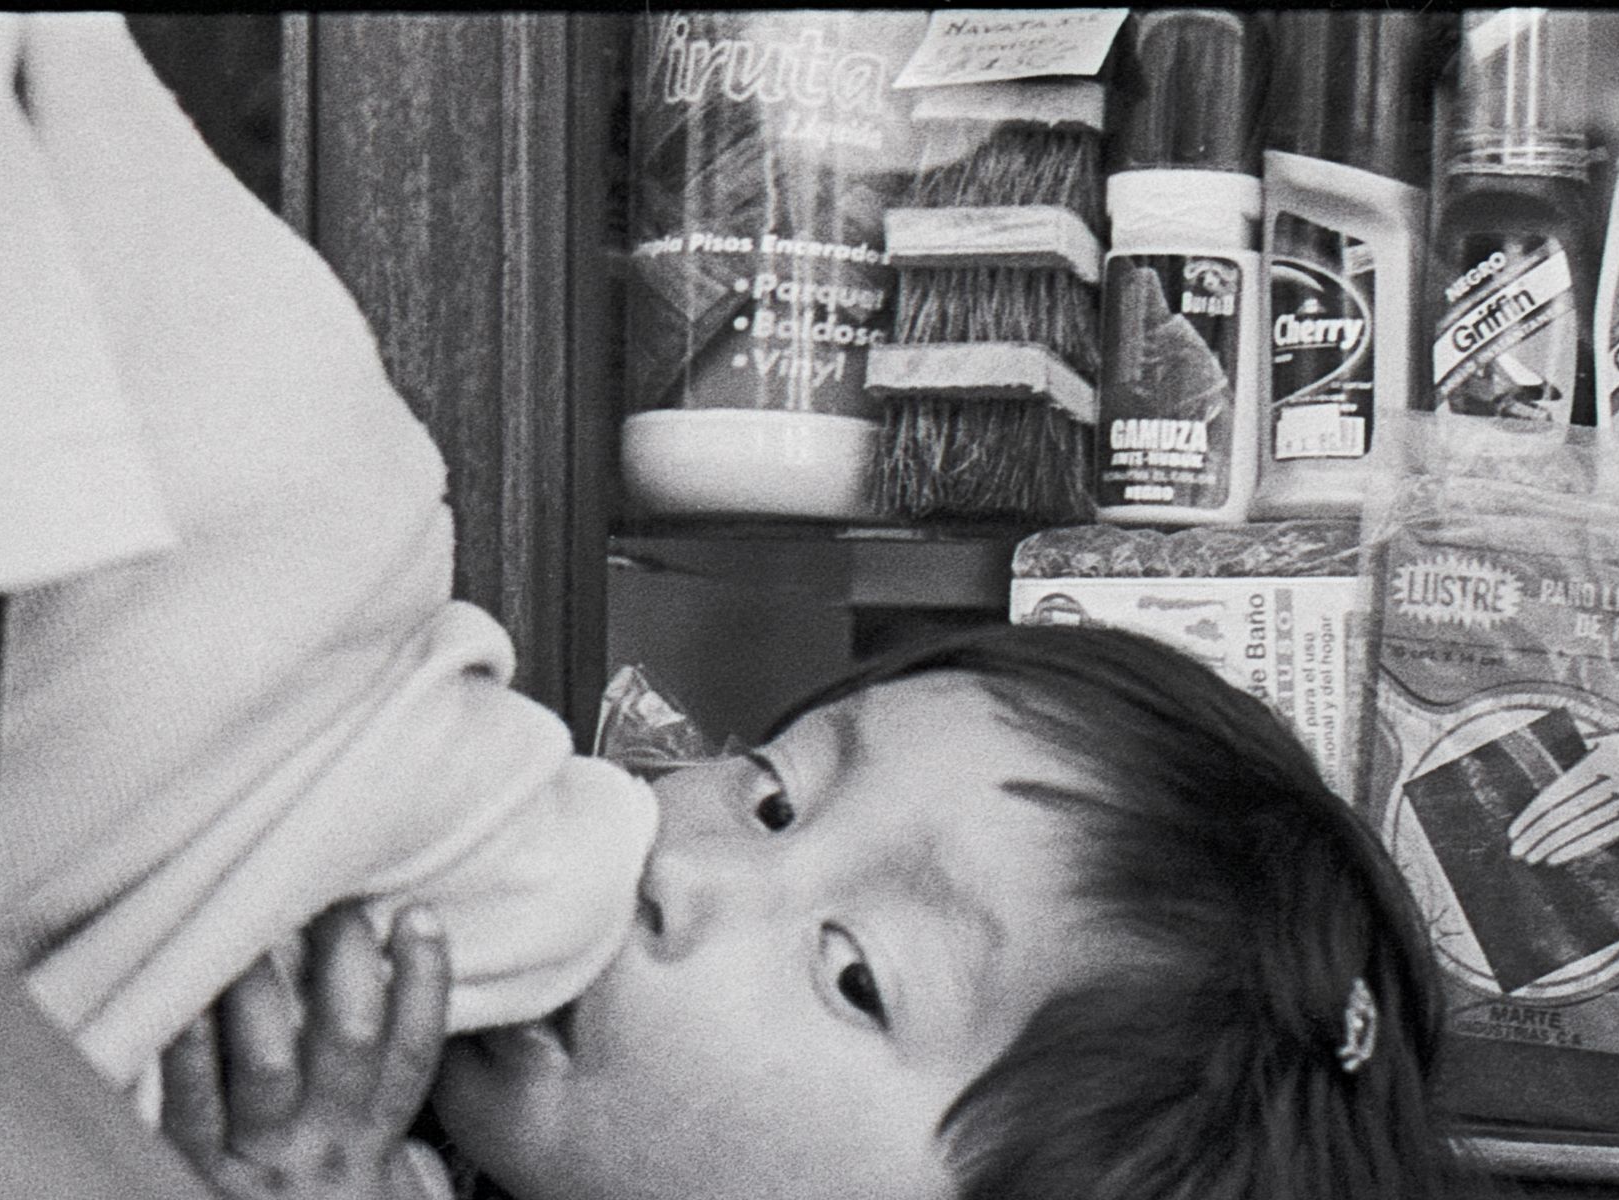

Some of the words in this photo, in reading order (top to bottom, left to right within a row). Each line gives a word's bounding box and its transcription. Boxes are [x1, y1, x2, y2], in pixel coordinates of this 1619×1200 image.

[687, 231, 754, 254] Pisos
[1444, 249, 1508, 305] NEGRO
[1273, 313, 1365, 351] Cherry
[1450, 283, 1537, 357] Griffin
[751, 348, 847, 390] Vinyl
[1406, 574, 1506, 615] LUSTRE
[1244, 593, 1267, 661] Baño
[1321, 615, 1336, 665] hogar
[1576, 612, 1604, 640] DE
[1304, 631, 1317, 663] uso
[1302, 665, 1316, 683] el
[1321, 669, 1335, 697] del
[1305, 689, 1320, 727] para
[1325, 702, 1339, 715] y
[1489, 1006, 1562, 1029] MARTE
